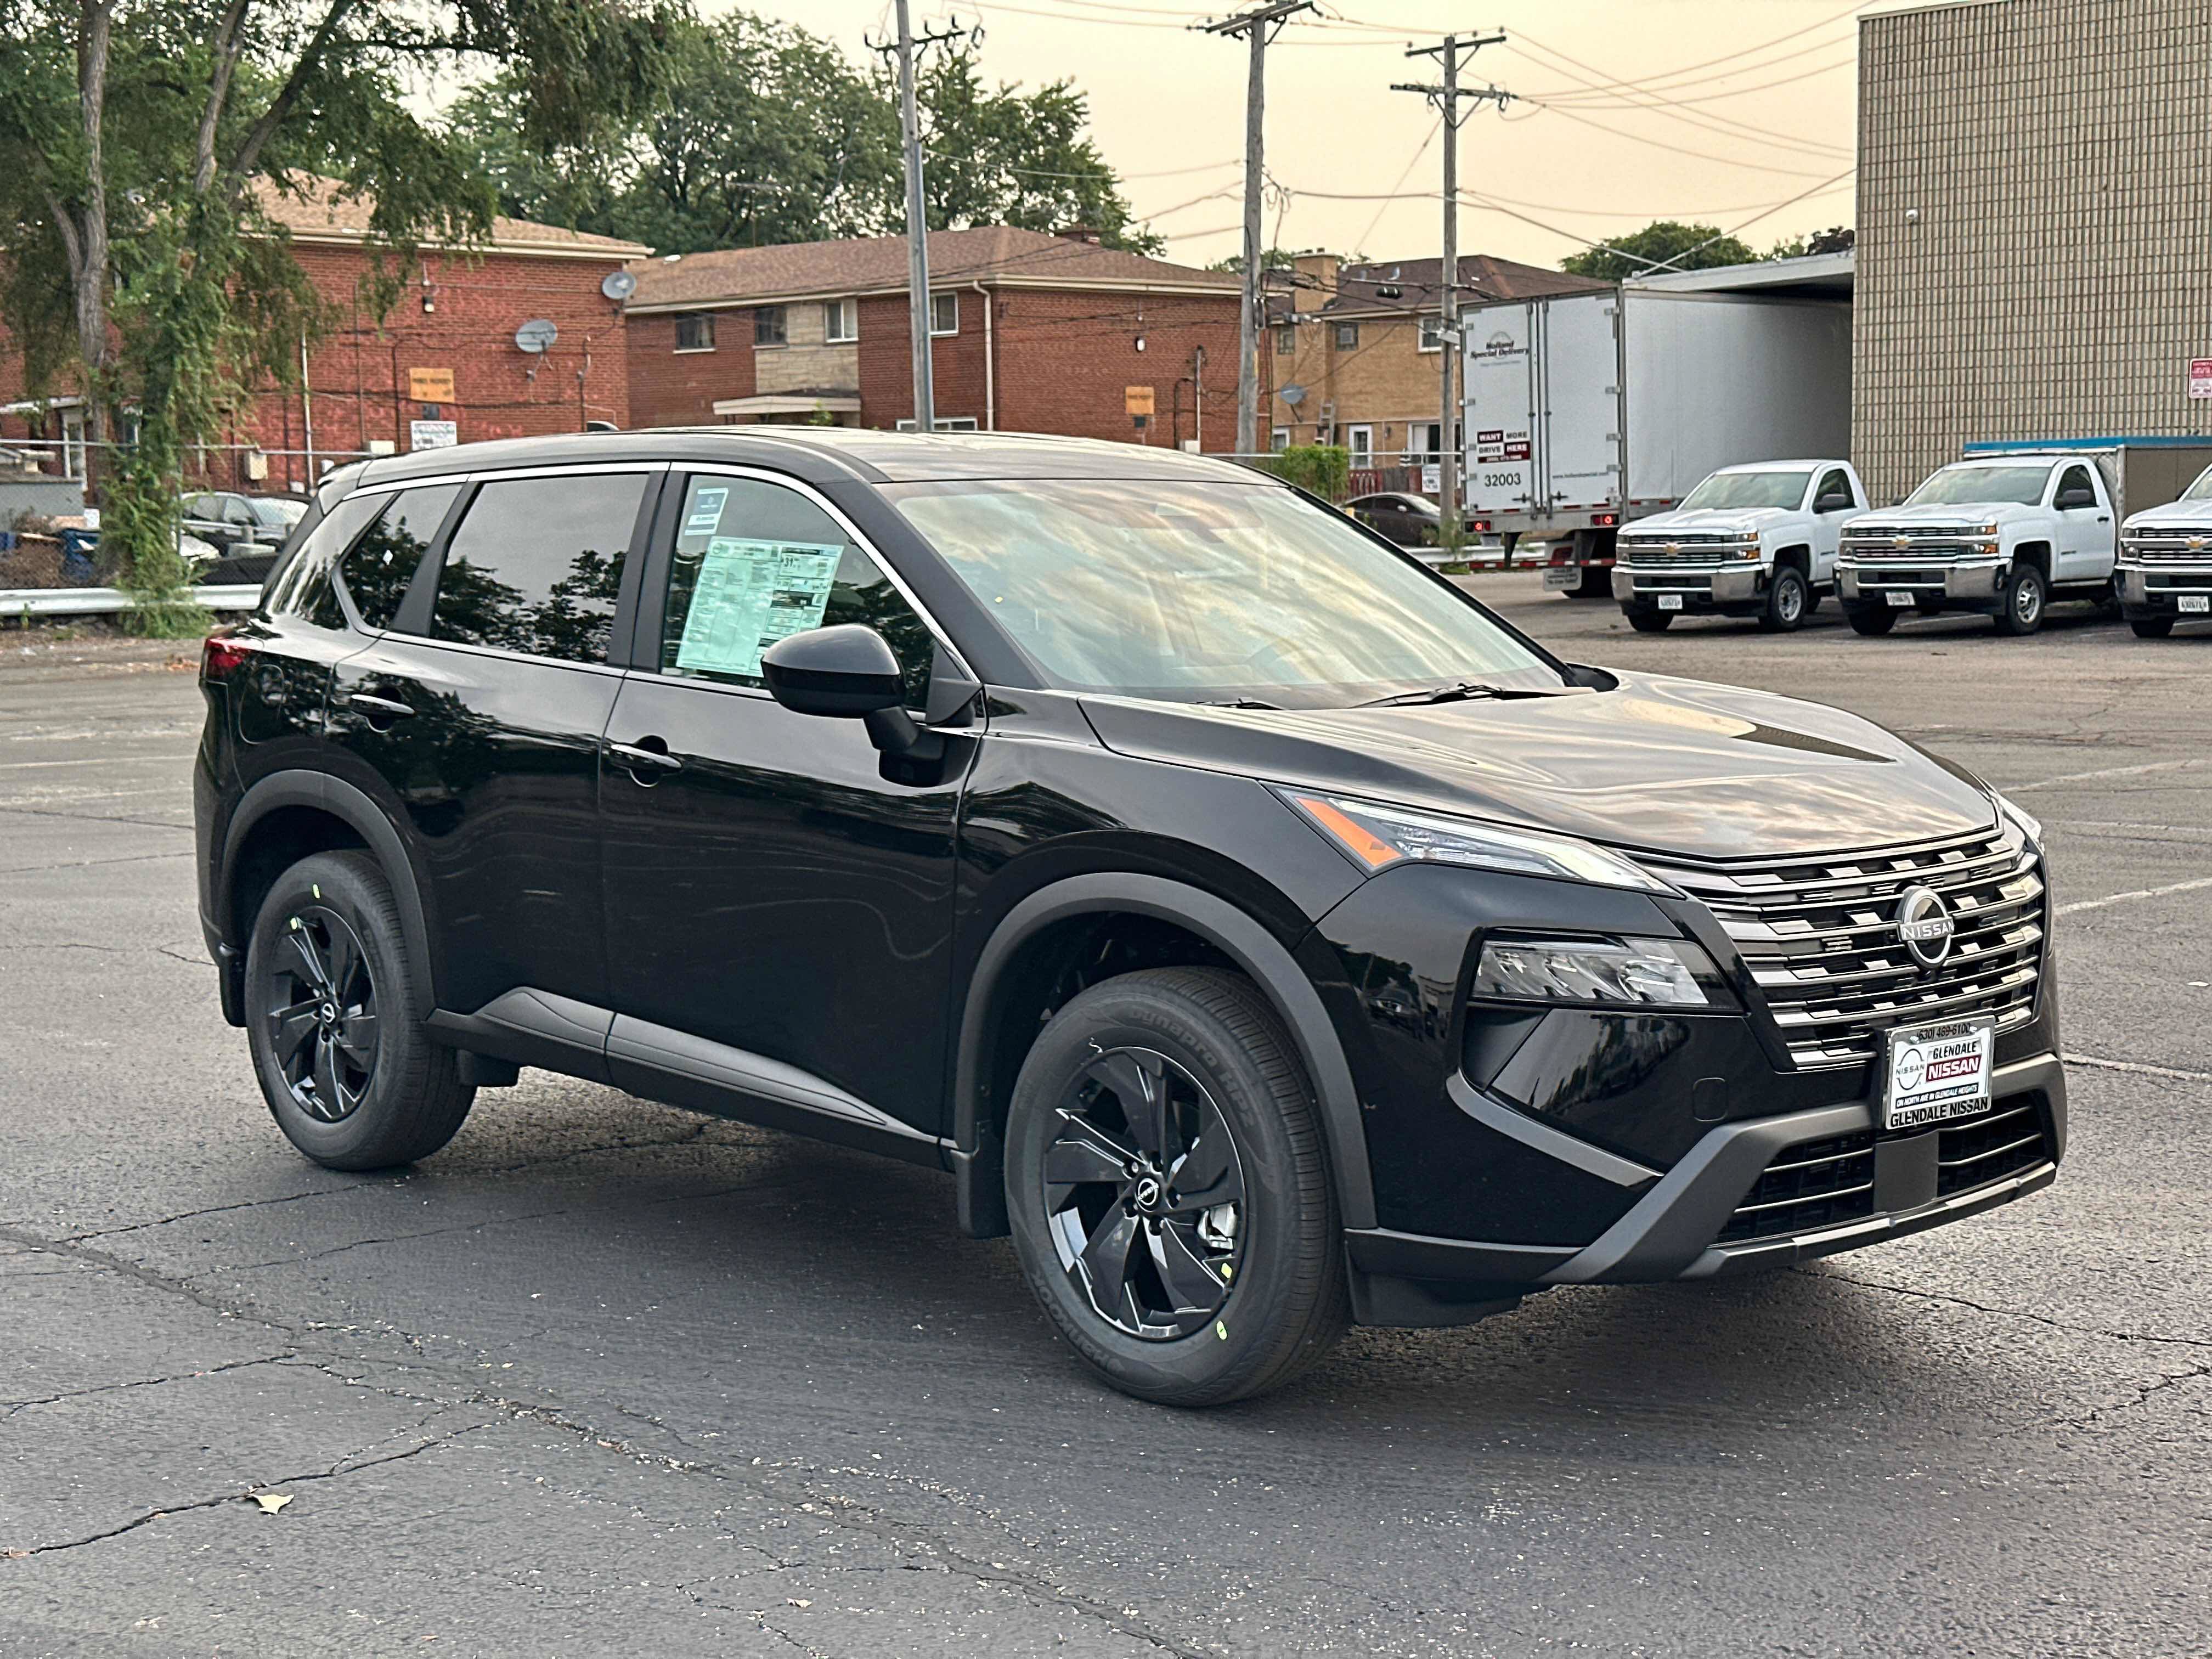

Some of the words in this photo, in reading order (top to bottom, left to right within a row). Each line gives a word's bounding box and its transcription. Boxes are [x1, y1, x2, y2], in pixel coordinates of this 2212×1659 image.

[1486, 340, 1514, 350] Holland
[1471, 350, 1497, 360] Special
[1498, 348, 1529, 357] Delivery
[1479, 433, 1502, 441] WANT
[1479, 445, 1501, 454] DRIVE
[1506, 443, 1527, 452] HERE
[1485, 472, 1521, 487] 32003
[1903, 921, 1955, 939] NISSAN
[1933, 1041, 1977, 1059] GLENDALE
[1896, 1064, 1925, 1075] NISSAN
[1928, 1057, 1979, 1080] NISSAN
[1891, 1105, 1947, 1128] GLENDALE
[1950, 1097, 1988, 1116] NISSAN
